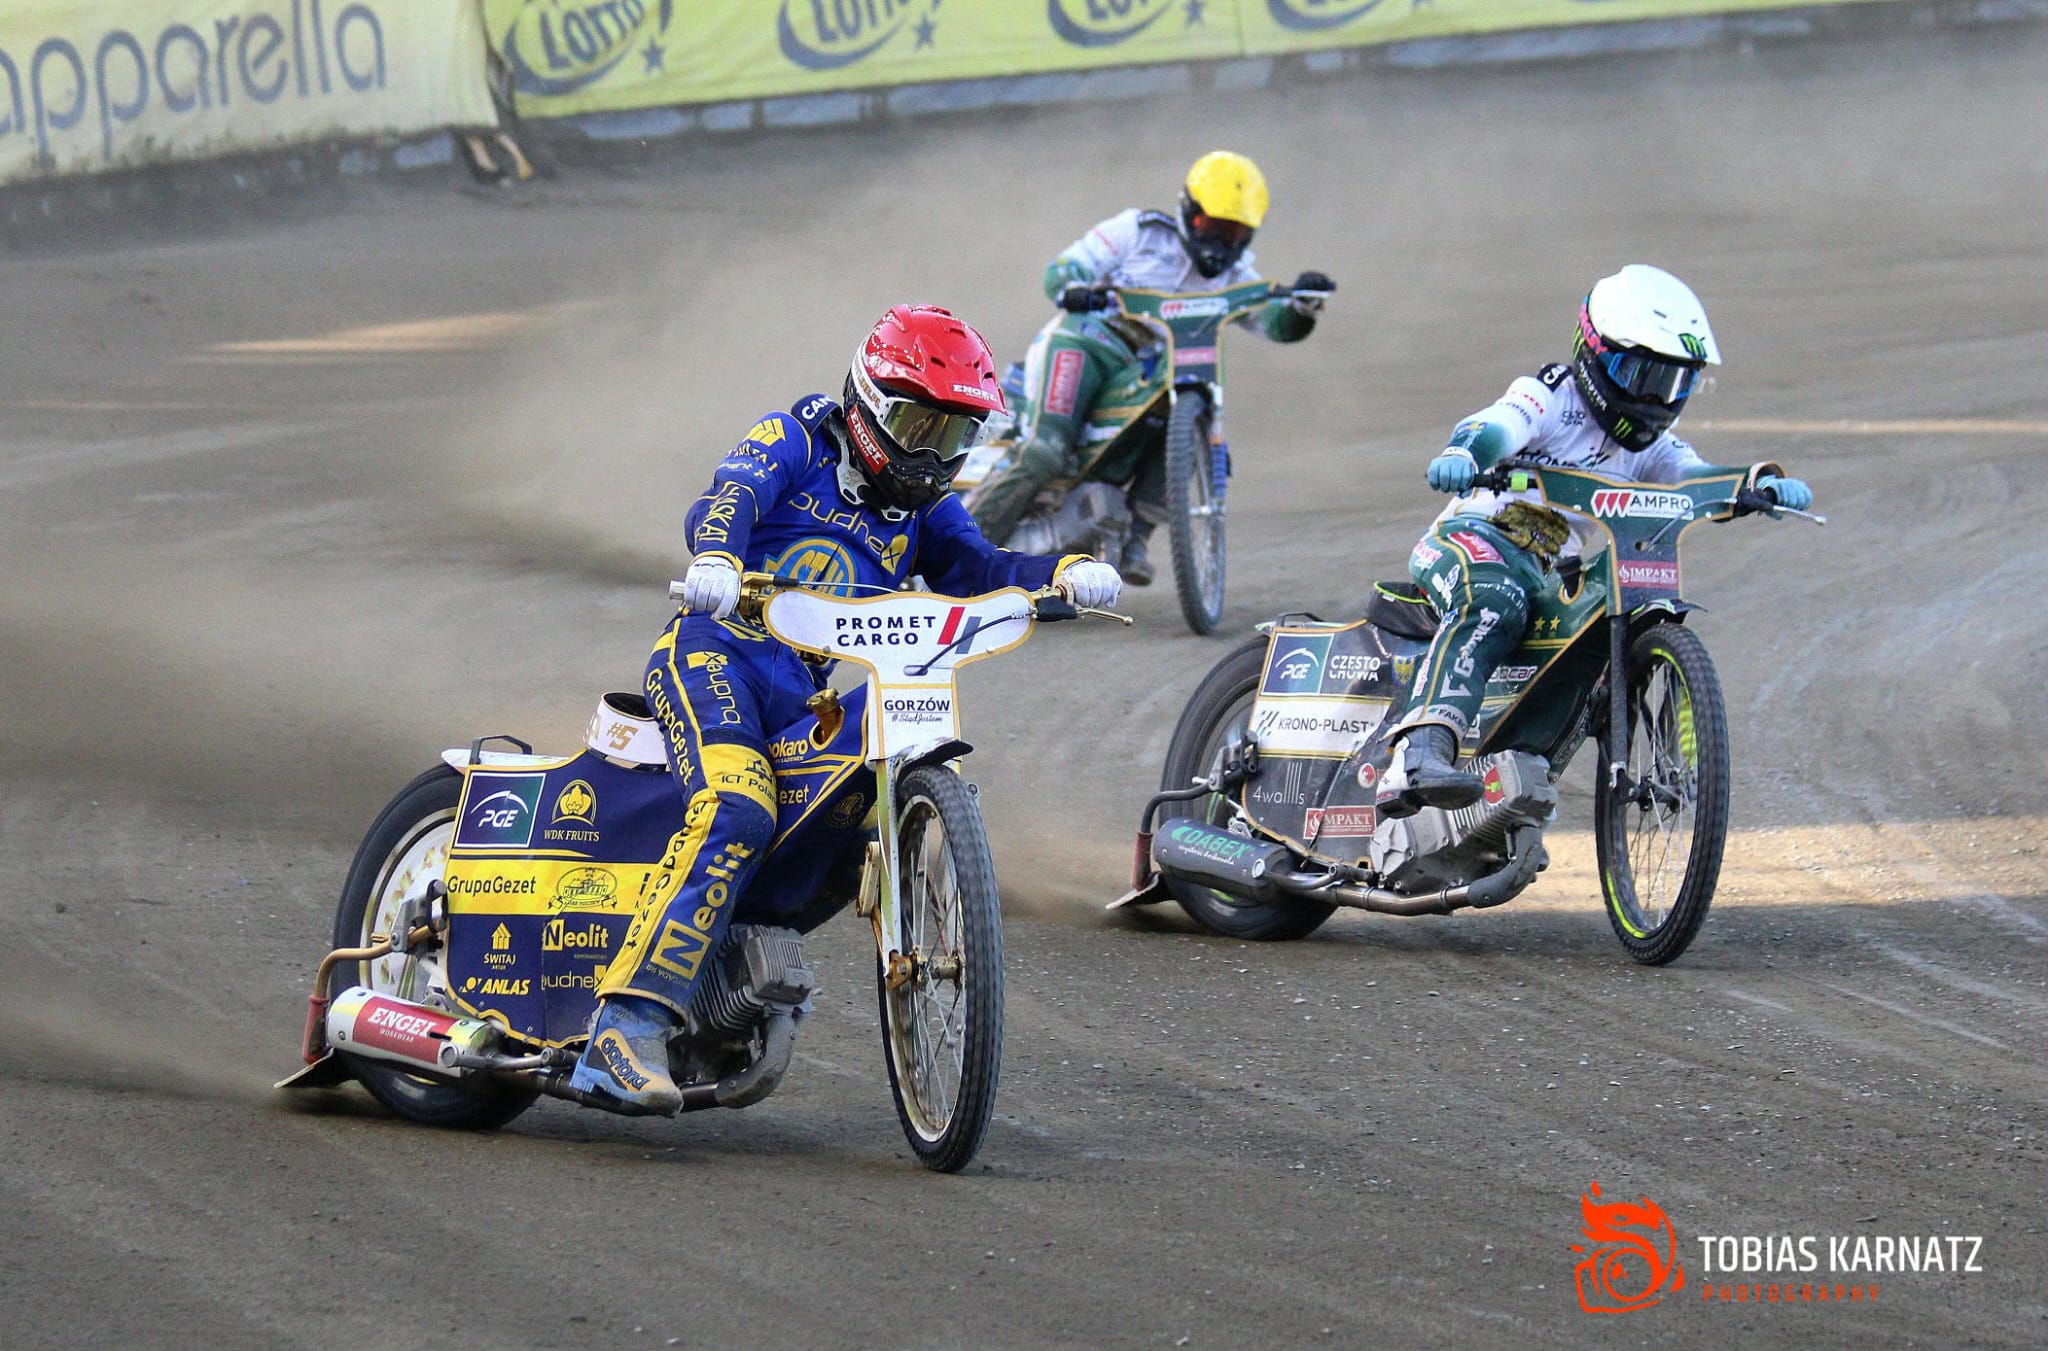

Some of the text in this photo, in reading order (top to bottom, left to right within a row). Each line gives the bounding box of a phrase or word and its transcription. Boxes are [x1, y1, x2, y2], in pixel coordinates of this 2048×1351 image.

[952, 384, 998, 401] ENGEL
[850, 412, 883, 465] ENGEL
[1630, 494, 1691, 511] AMPRO
[1630, 566, 1678, 579] IMPAKT
[836, 615, 937, 631] PROMET
[837, 632, 919, 647] CARGO
[1281, 664, 1311, 679] PGE
[884, 696, 950, 711] GORZÓW
[646, 668, 696, 786] GrupaGezet
[1278, 718, 1369, 734] KRONO-PLAST
[721, 774, 777, 804] ICT Polan
[779, 784, 810, 805] ezet
[478, 809, 519, 828] PGE
[1321, 813, 1372, 826] MPAKT
[544, 829, 600, 842] WDK FRUITS
[447, 875, 537, 896] GrupaGezet
[651, 843, 756, 981] Neolit
[543, 918, 609, 951] Neolit
[368, 1007, 437, 1038] ENGEL
[380, 1027, 415, 1042] WORKWEAR
[601, 1037, 651, 1091] daytona
